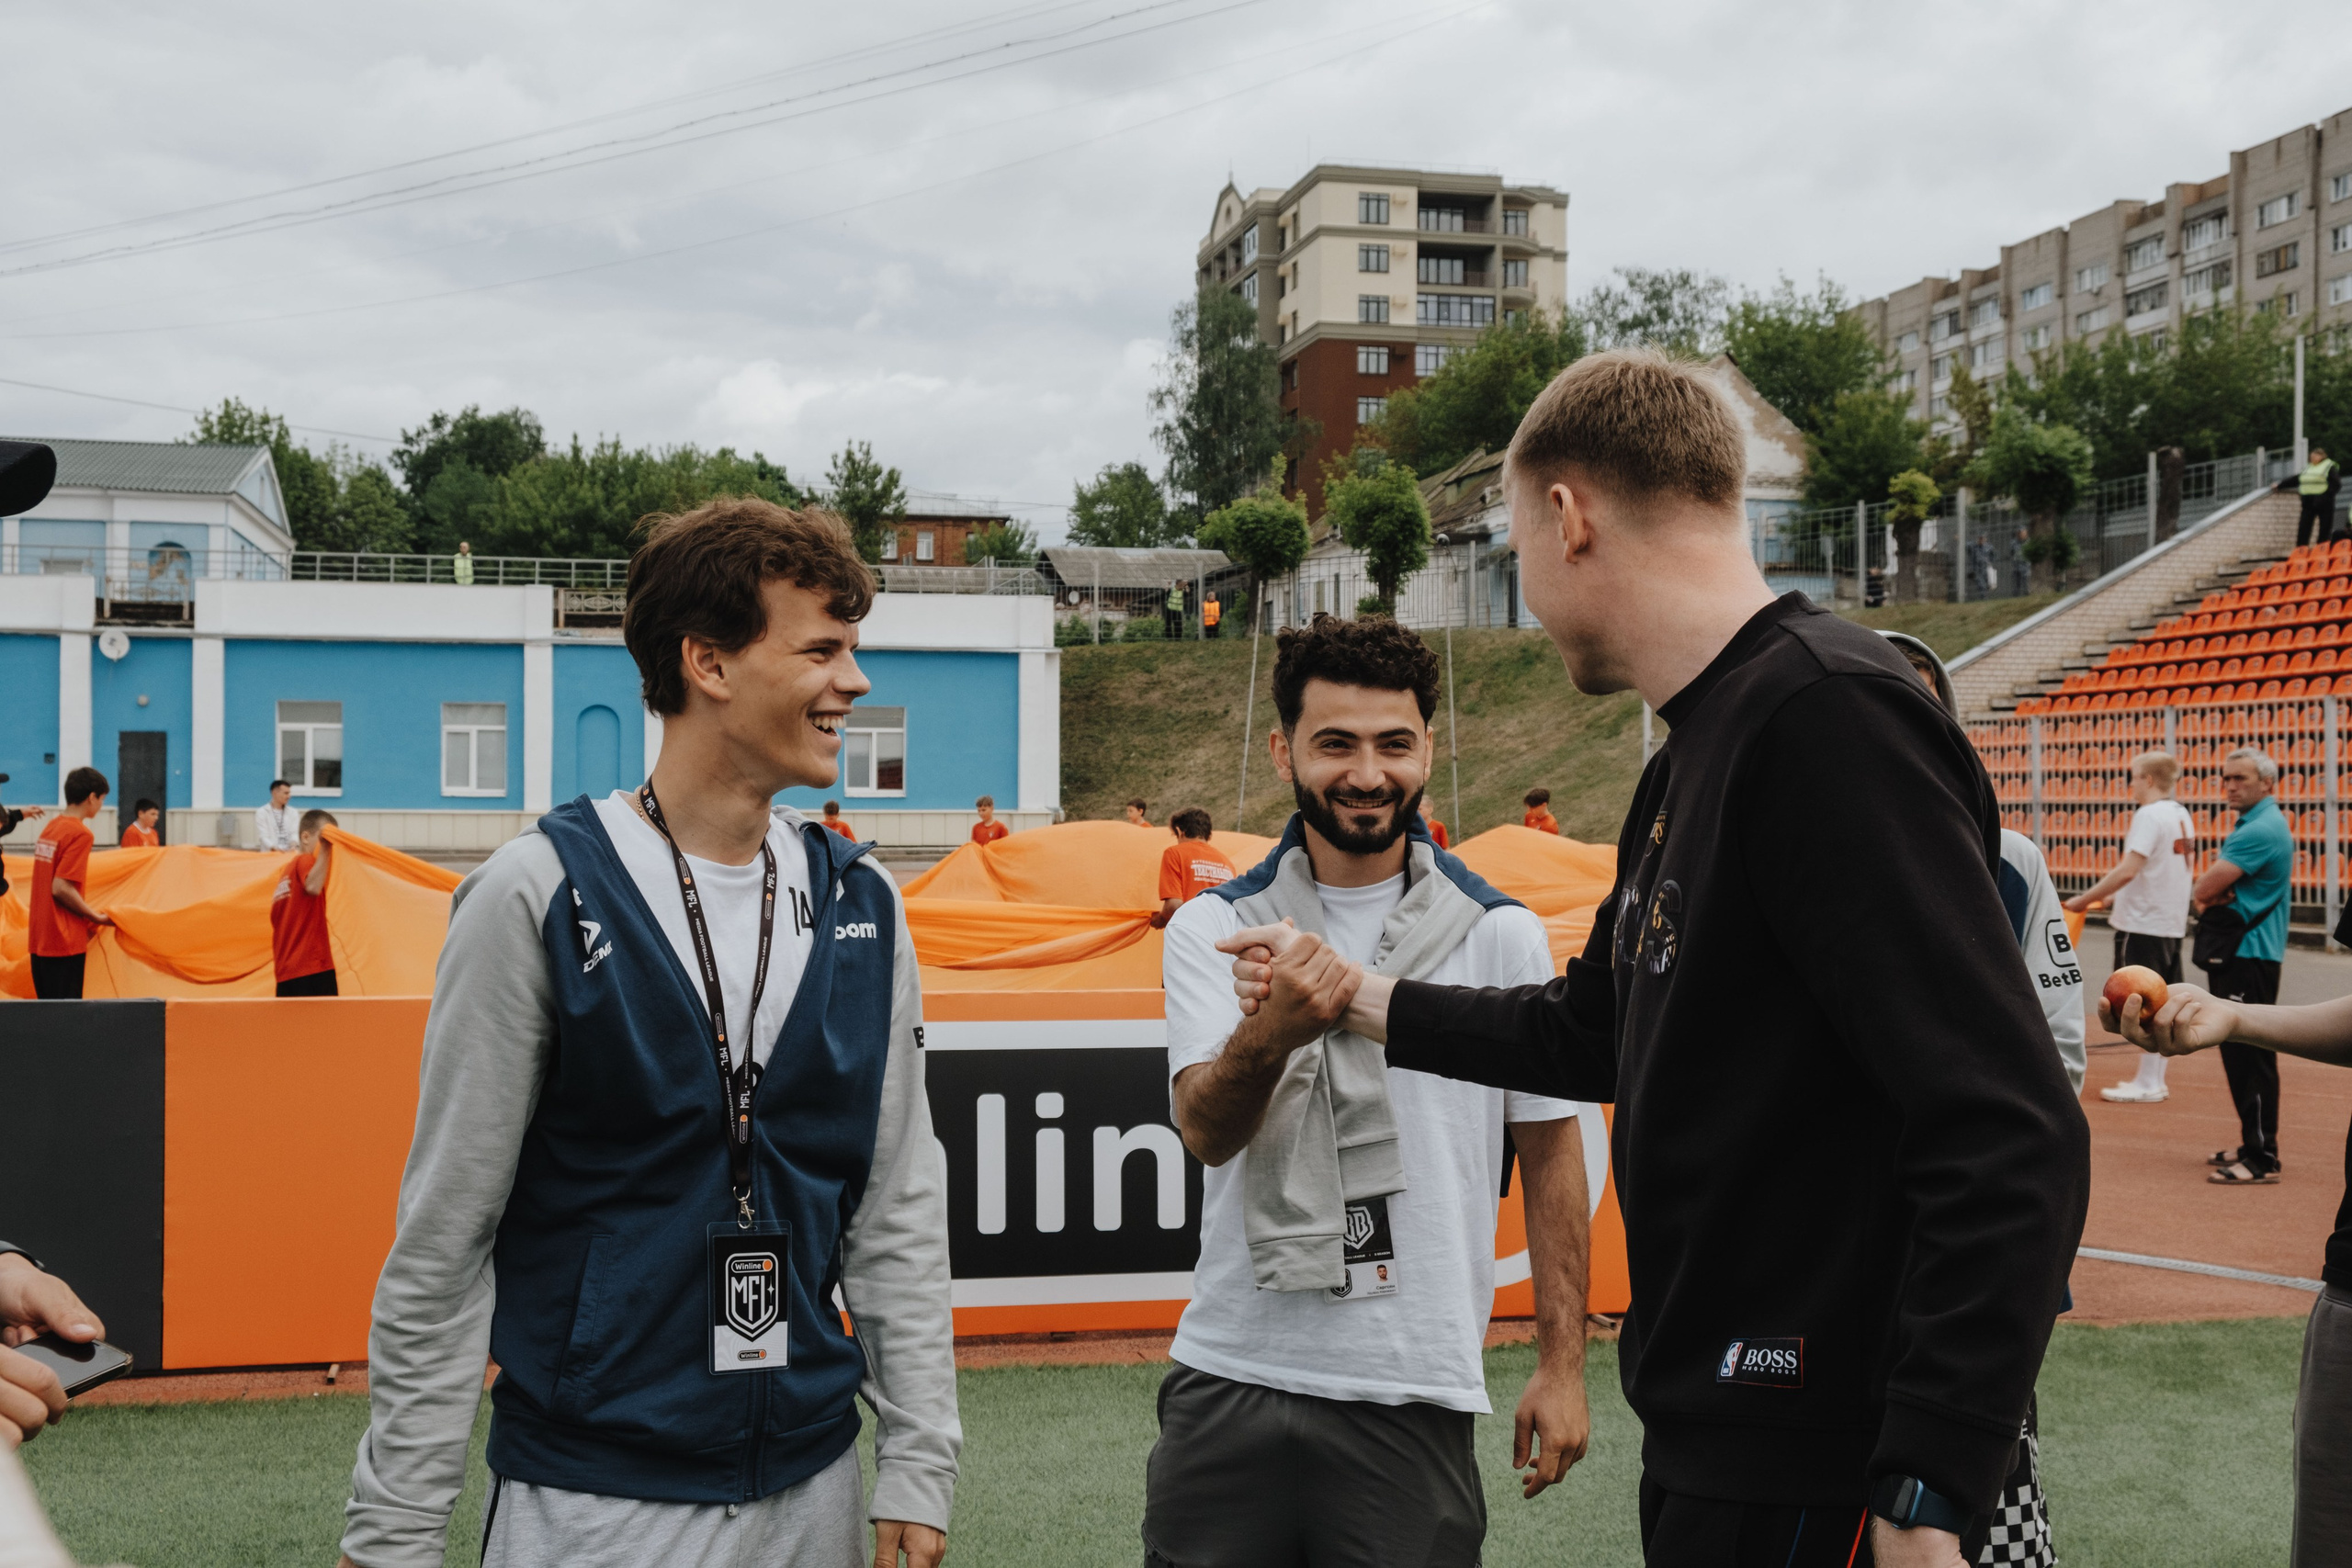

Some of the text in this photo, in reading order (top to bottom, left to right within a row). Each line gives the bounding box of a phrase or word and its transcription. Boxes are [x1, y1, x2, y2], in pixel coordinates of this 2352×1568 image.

[644, 796, 656, 815] MFL
[766, 873, 775, 889] MFL
[685, 889, 697, 908] MFL
[835, 922, 876, 942] oom
[2052, 933, 2071, 953] B
[699, 935, 708, 961] FOOTBALL
[705, 961, 714, 982] LEAGUE
[2038, 968, 2083, 988] BetB
[718, 1047, 729, 1066] MFL
[740, 1090, 751, 1109] MFL
[934, 1091, 1186, 1235] lin
[735, 1262, 762, 1270] Winline
[731, 1275, 773, 1330] MFL
[1744, 1348, 1797, 1369] BOSS
[1770, 1367, 1796, 1375] BOSS
